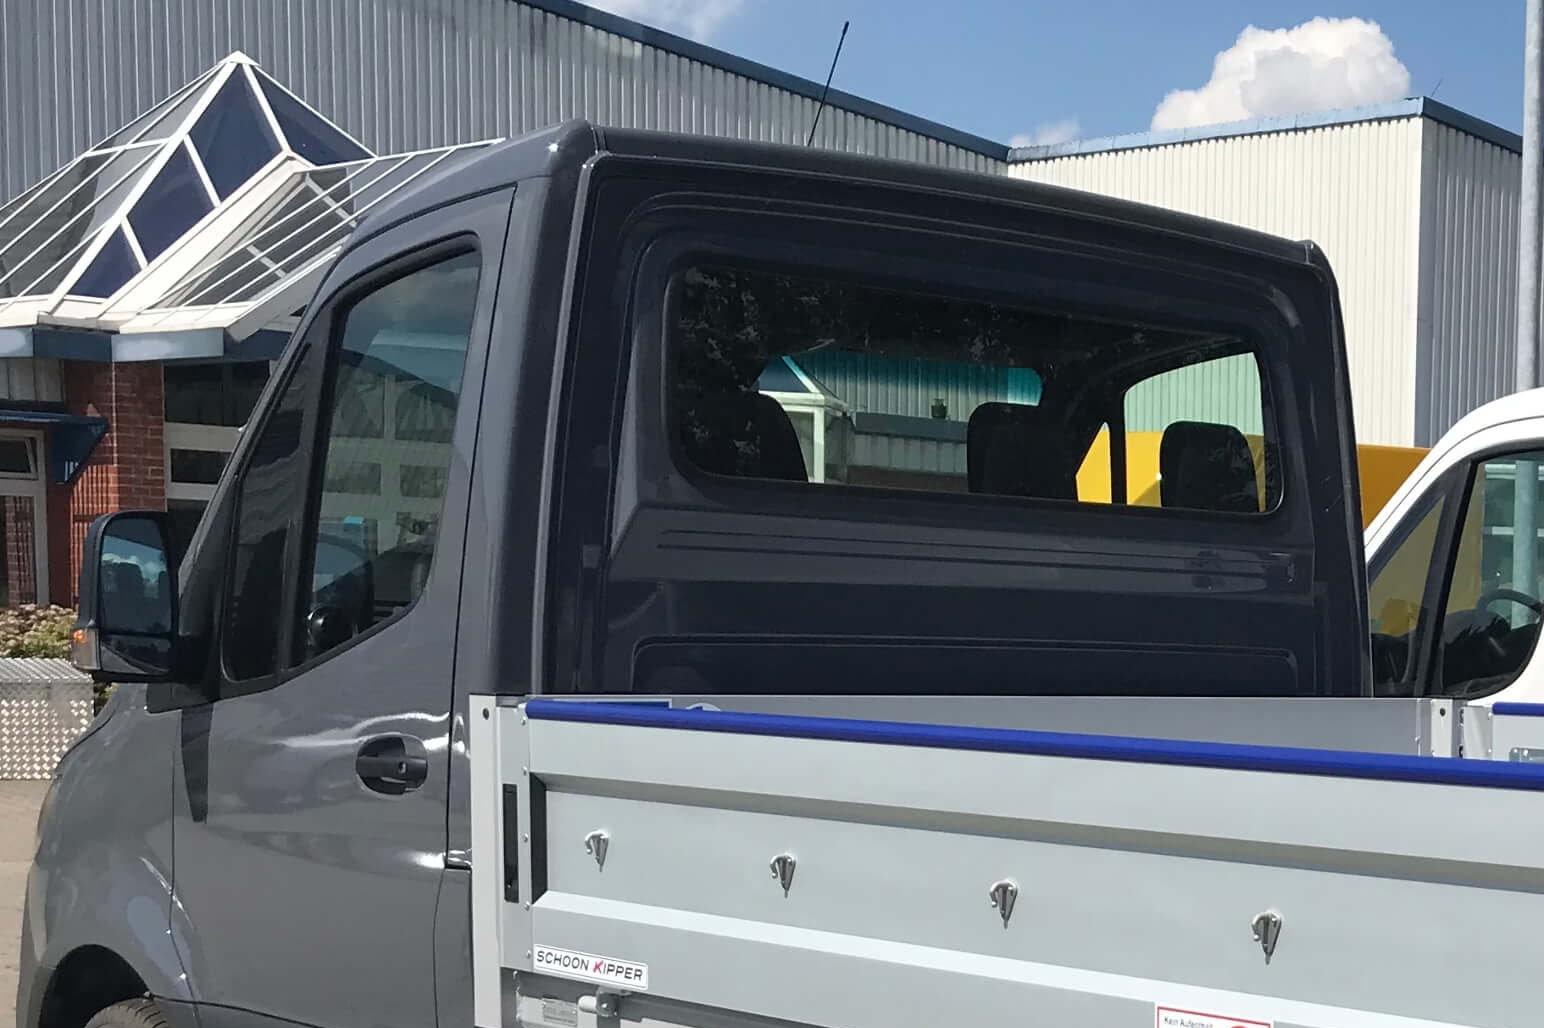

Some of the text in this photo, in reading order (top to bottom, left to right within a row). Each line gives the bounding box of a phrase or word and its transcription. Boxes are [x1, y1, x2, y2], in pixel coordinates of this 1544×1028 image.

[536, 950, 644, 981] SCHOON KIPPER
[1164, 1015, 1178, 1026] Kein
